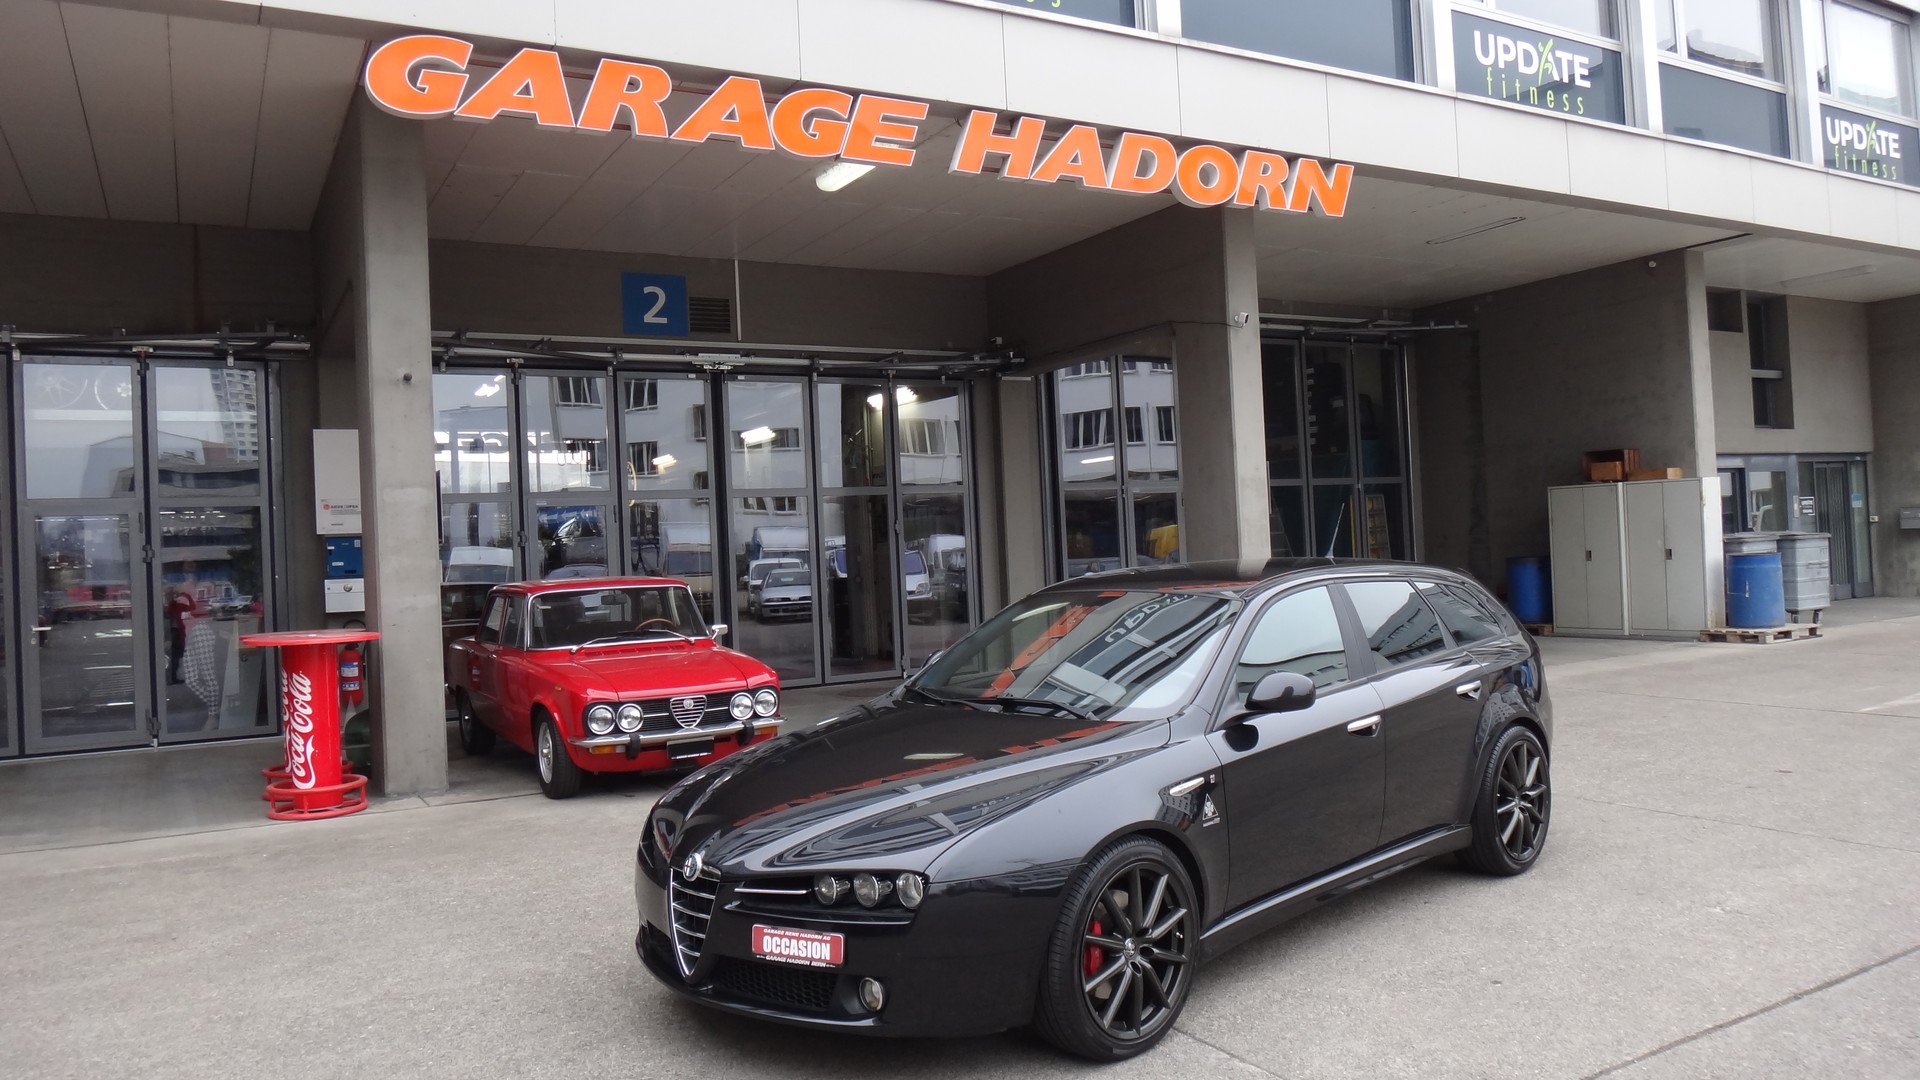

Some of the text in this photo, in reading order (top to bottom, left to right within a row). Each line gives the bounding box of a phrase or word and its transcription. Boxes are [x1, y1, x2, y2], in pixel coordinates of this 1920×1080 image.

[1474, 30, 1591, 88] UPDATE
[1487, 67, 1584, 115] fitness
[365, 34, 1354, 217] GARAGE HADORN
[1825, 117, 1901, 159] UPDATE
[1834, 145, 1897, 180] fitness
[643, 286, 668, 323] 2
[763, 935, 831, 961] OCCASION
